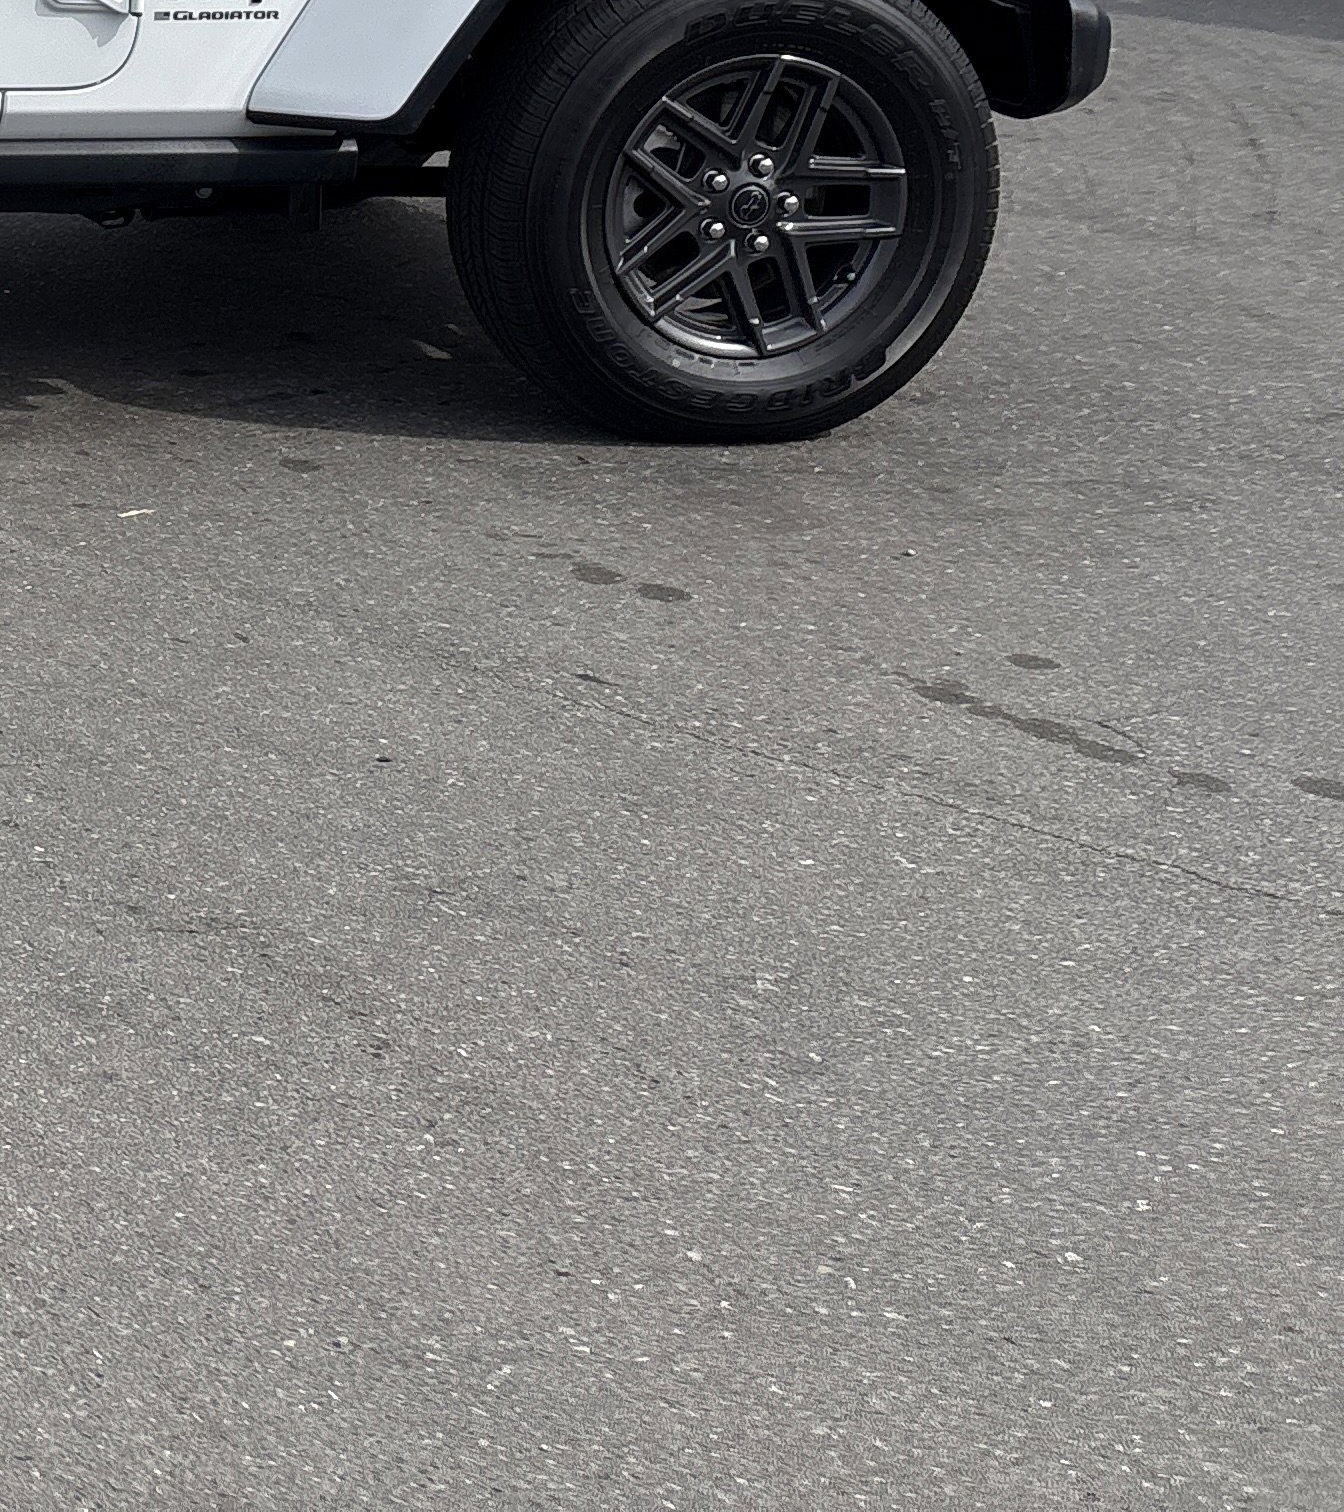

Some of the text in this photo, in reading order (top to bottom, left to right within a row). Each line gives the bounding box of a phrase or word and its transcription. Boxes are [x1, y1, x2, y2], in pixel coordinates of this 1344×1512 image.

[172, 10, 279, 21] GLADIATOR
[683, 0, 932, 92] DUELER
[567, 287, 888, 413] BRIDGESTONE
